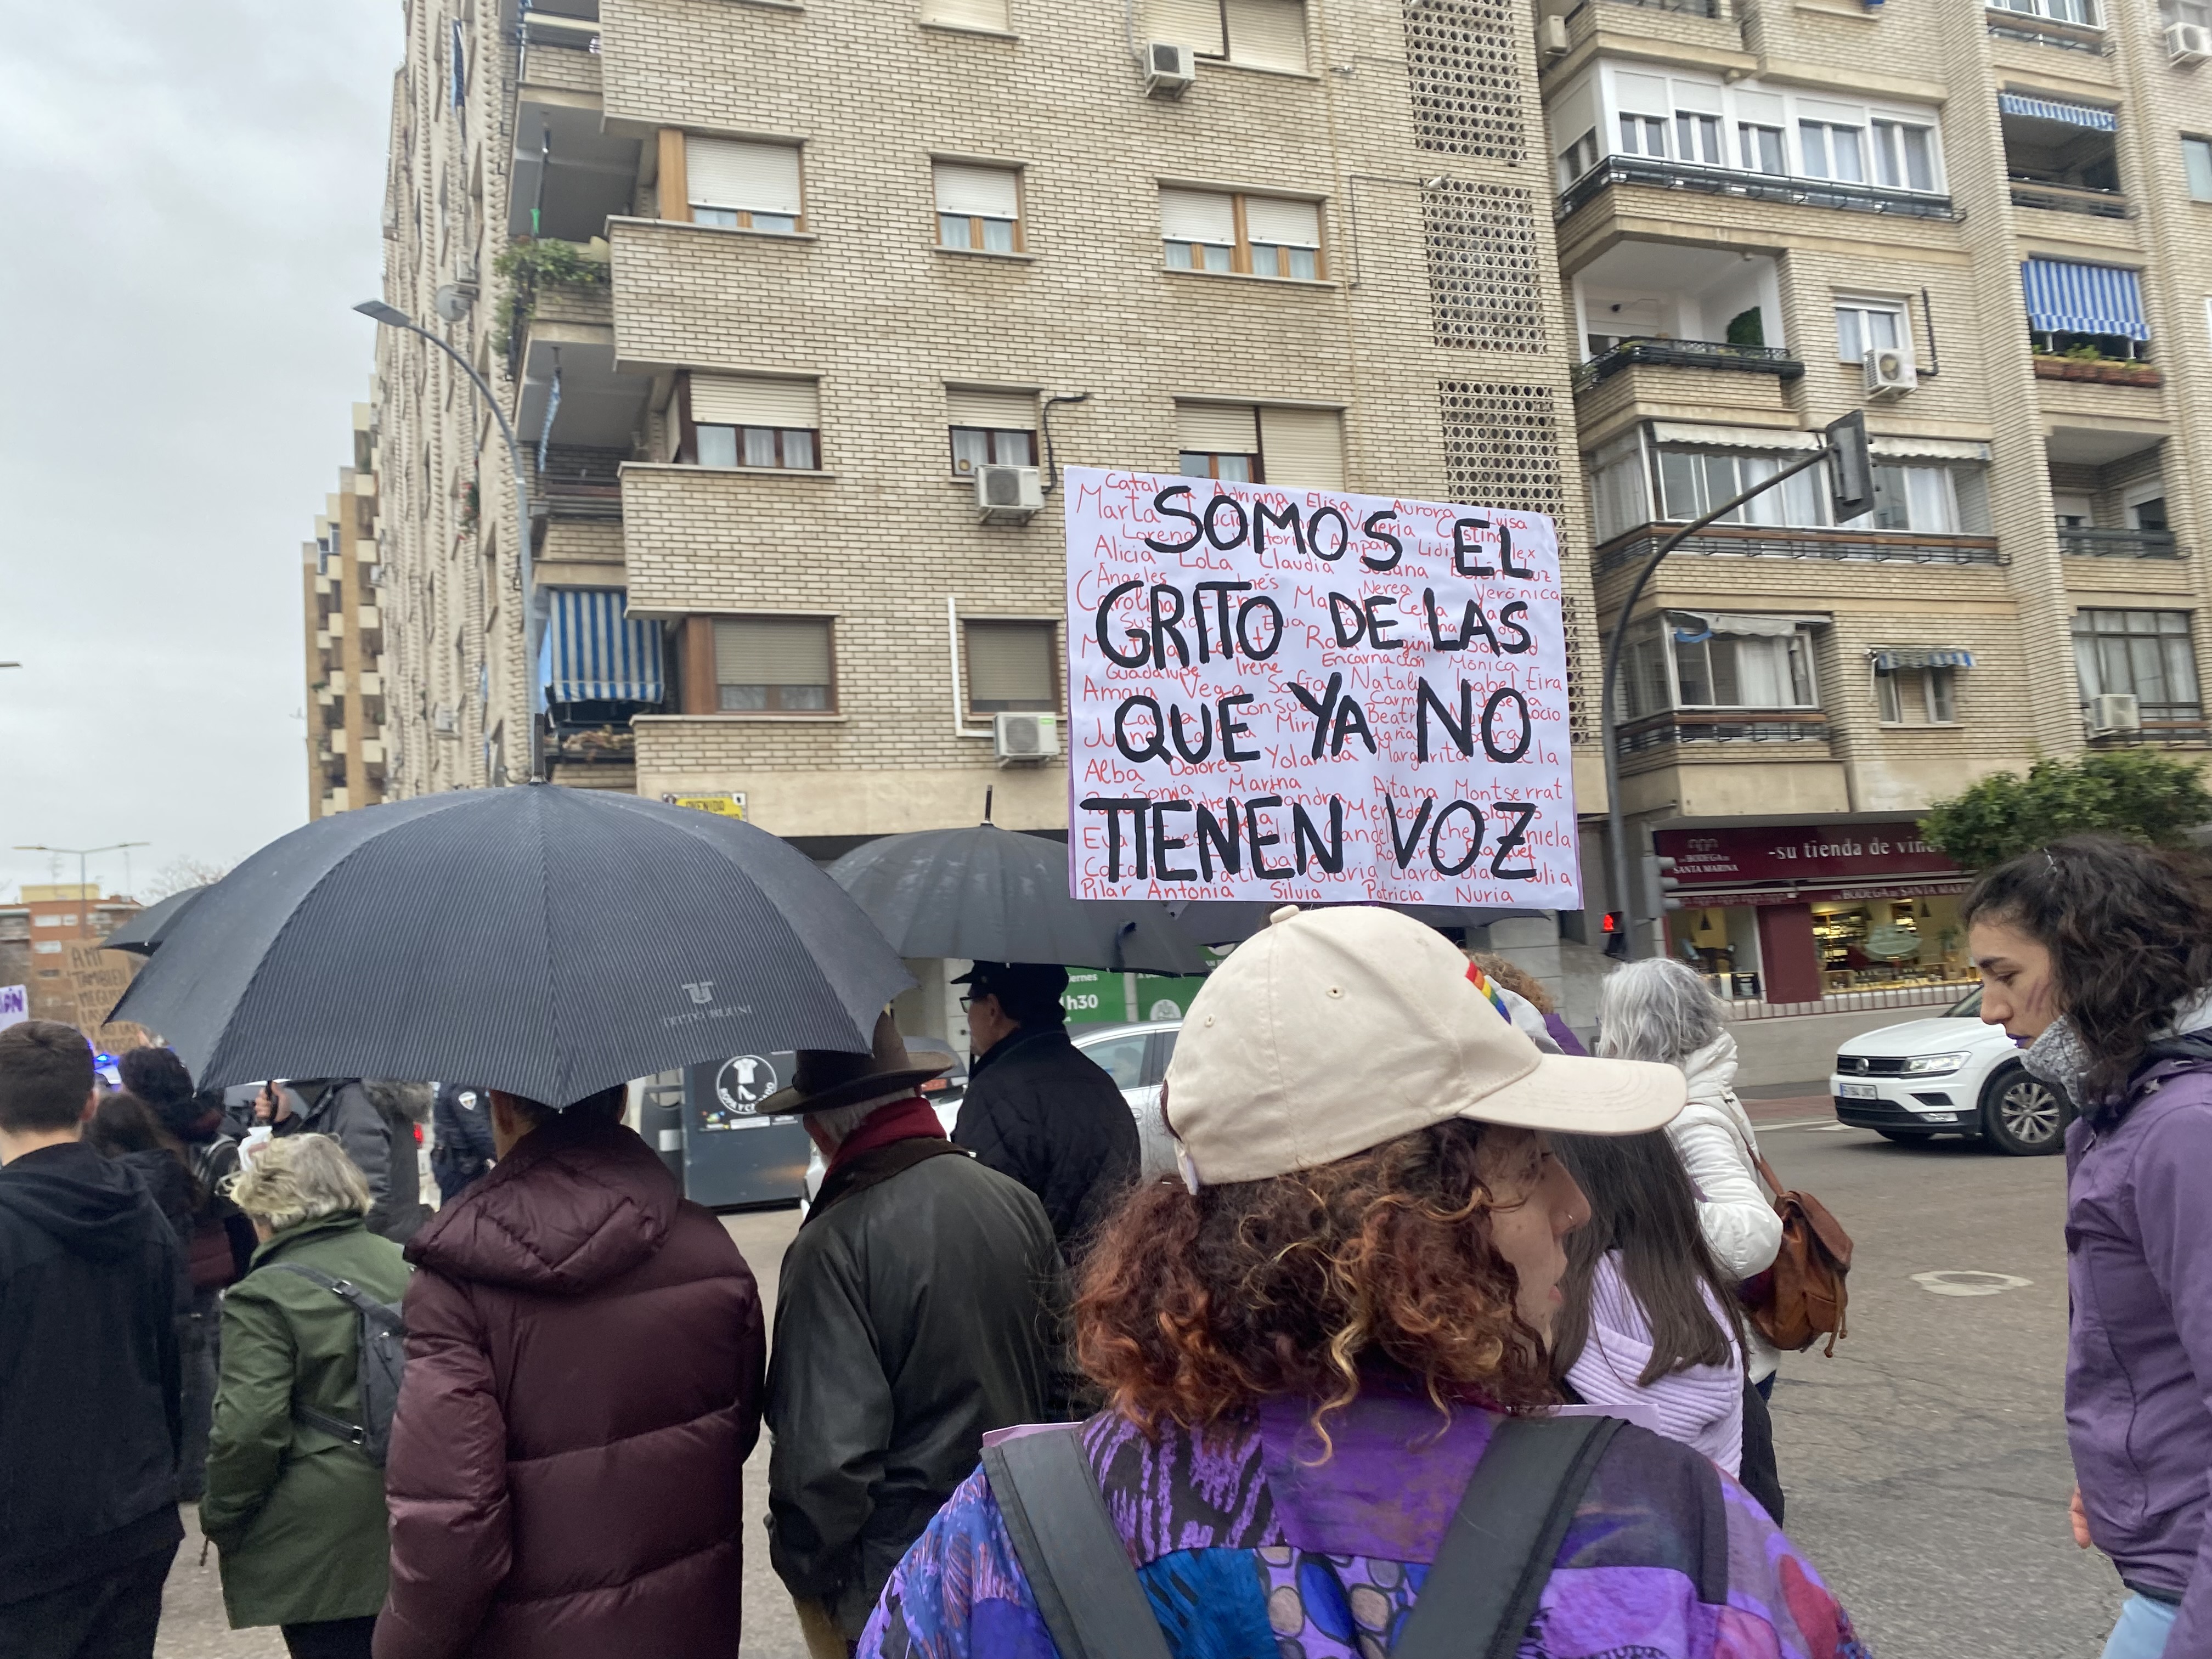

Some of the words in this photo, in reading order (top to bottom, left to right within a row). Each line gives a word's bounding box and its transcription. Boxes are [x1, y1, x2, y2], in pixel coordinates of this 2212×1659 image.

[1076, 483, 1161, 523] Marta
[1307, 492, 1353, 512] Elisa
[1393, 499, 1456, 519] Aurora
[1487, 510, 1527, 529] Luisa
[1145, 486, 1402, 571] SOMOS
[1454, 518, 1533, 578] EL
[1094, 534, 1156, 565] Alicia
[1259, 548, 1334, 574] Claudia
[1363, 580, 1413, 595] Nerea
[1474, 583, 1560, 601] Verónica
[1096, 580, 1283, 670] GRITO
[1329, 592, 1403, 650] DE
[1424, 588, 1531, 657] LAS
[1084, 675, 1159, 702] Amaia
[1181, 673, 1246, 707] Vega
[1351, 665, 1419, 690] Natali
[1106, 662, 1201, 681] Guadalupe
[1236, 657, 1283, 676] Irene
[1322, 651, 1425, 668] Encarnación
[1448, 654, 1520, 672] Mónica
[1115, 694, 1260, 765] QUE
[1287, 673, 1376, 760] YA
[1417, 677, 1531, 764] NO
[1085, 759, 1146, 783] Alba
[1169, 755, 1242, 776] Dolores
[1378, 741, 1470, 771] Margrita
[1133, 781, 1194, 801] Sonia
[1229, 774, 1302, 793] Marina
[1373, 774, 1439, 799] Aitana
[1454, 777, 1563, 801] Montserrat
[1080, 795, 1343, 883] TIENEN
[1385, 793, 1536, 879] VOZ
[1803, 839, 1863, 857] tienda
[1868, 838, 1891, 855] de
[1080, 877, 1132, 900] Pilar
[1147, 879, 1234, 900] Antonia
[1269, 881, 1322, 900] Silvia
[1361, 878, 1424, 901] Patricia
[1455, 884, 1514, 904] Nuria
